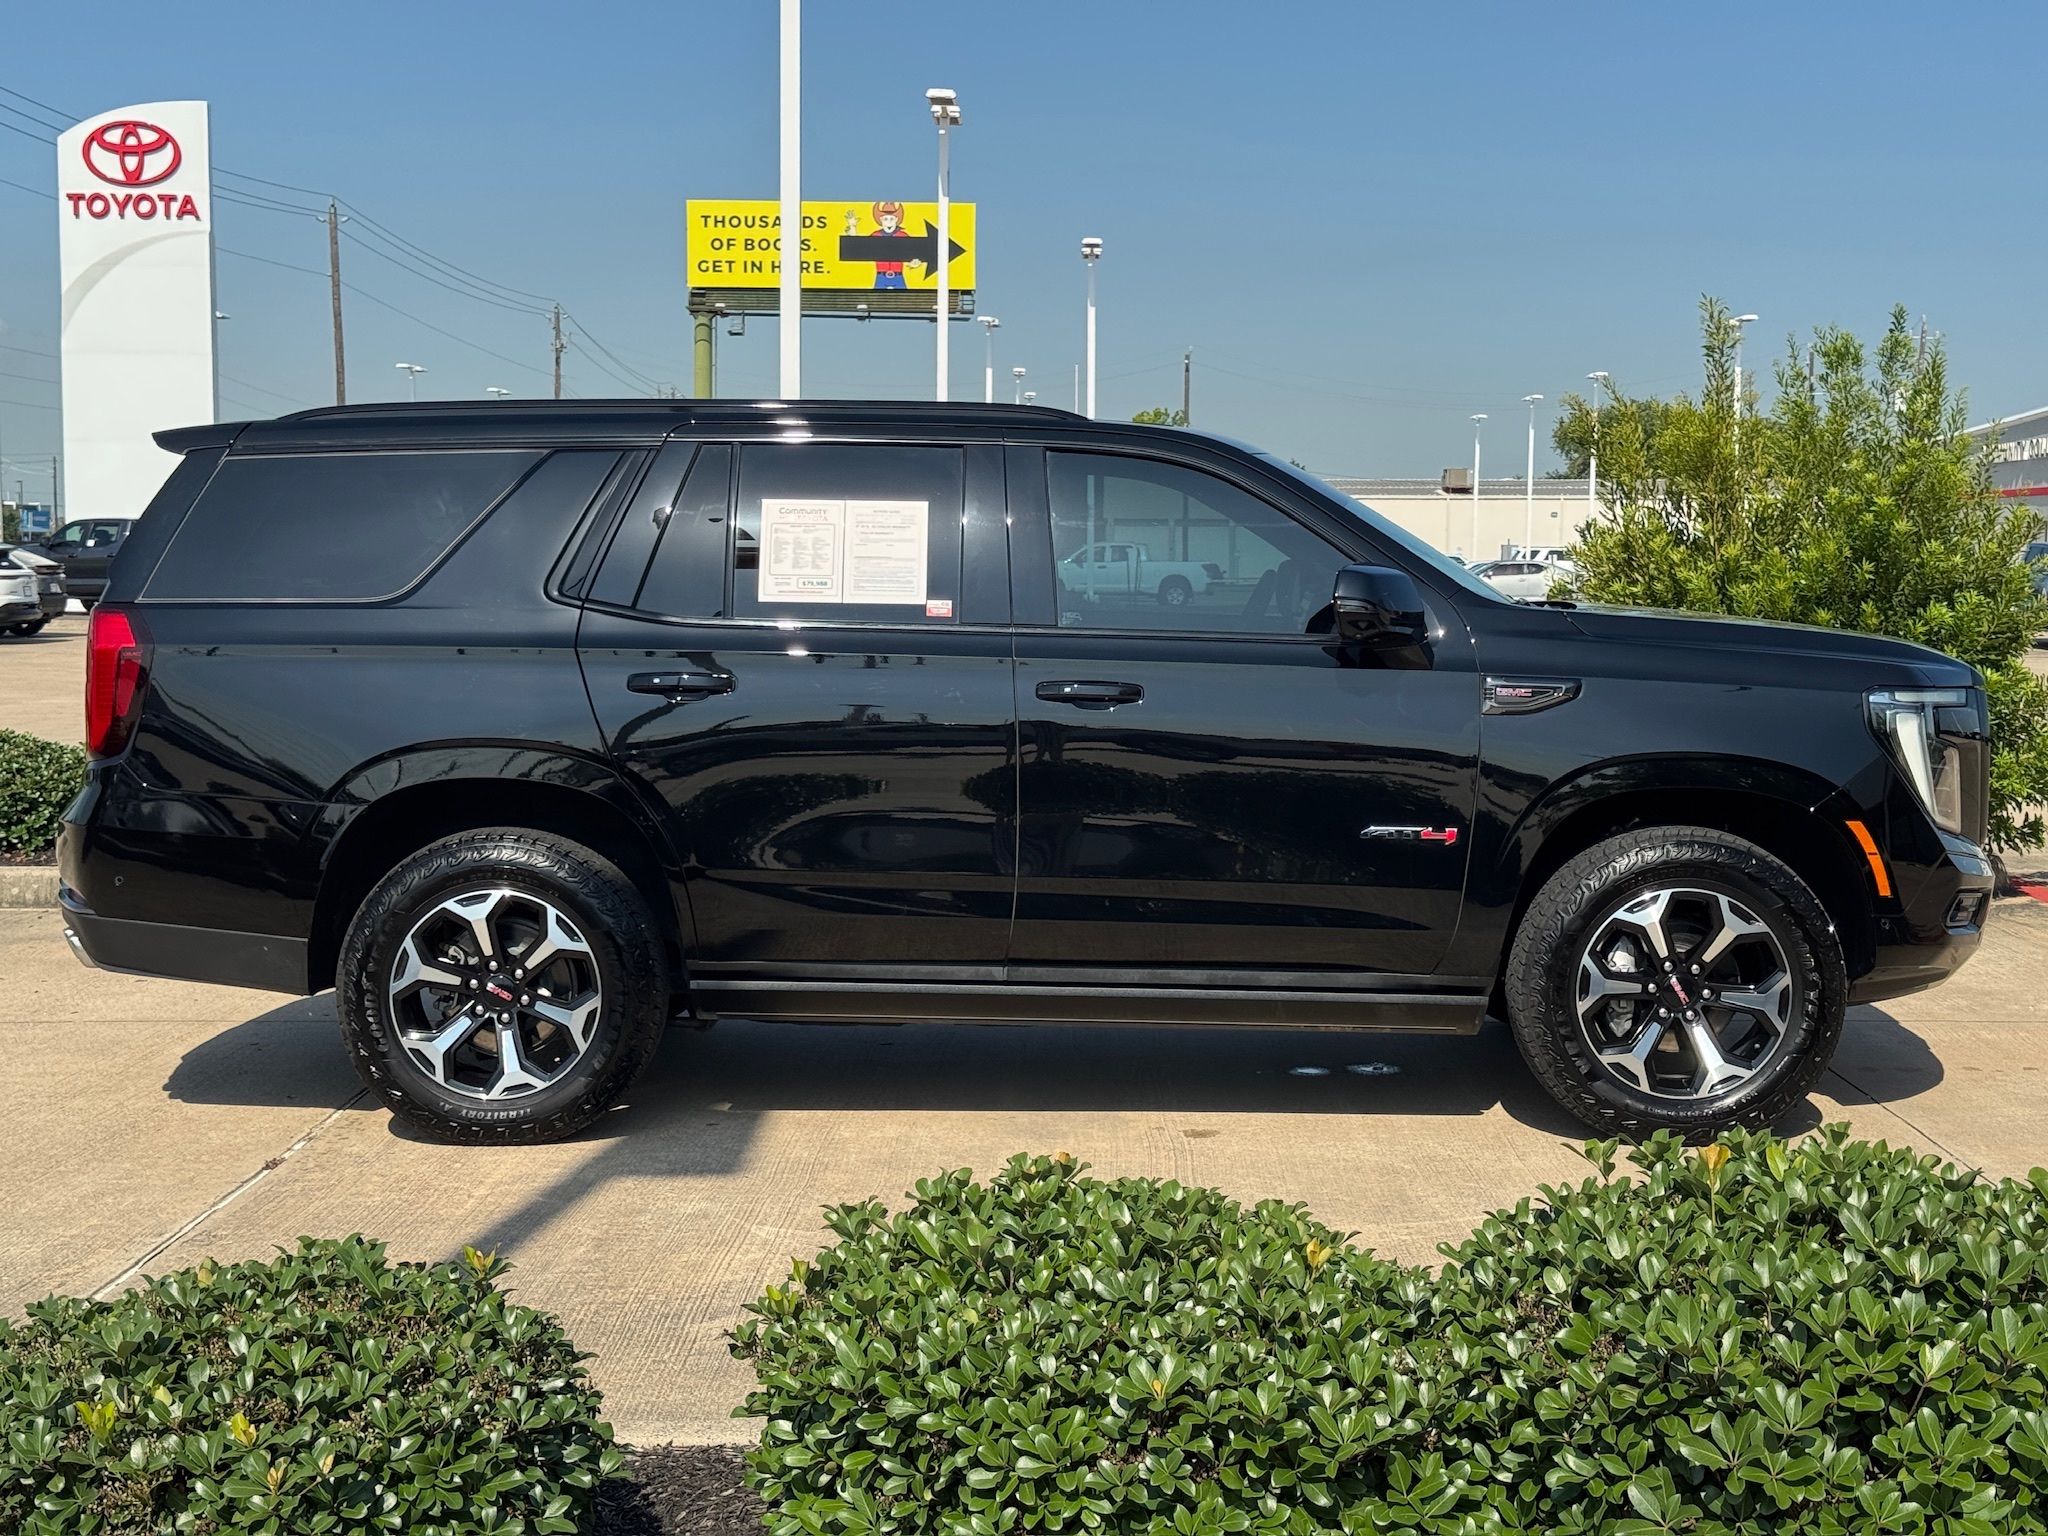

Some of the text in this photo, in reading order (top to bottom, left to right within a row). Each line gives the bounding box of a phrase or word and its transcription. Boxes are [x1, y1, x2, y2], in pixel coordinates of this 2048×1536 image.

[66, 193, 201, 221] TOYOTA
[700, 215, 828, 229] THOUSADS
[710, 238, 817, 252] OF BOOS.
[697, 260, 830, 274] GET IN HRE.
[1495, 687, 1532, 697] GMC
[485, 982, 513, 1001] GMC
[1670, 975, 1690, 1005] GMC
